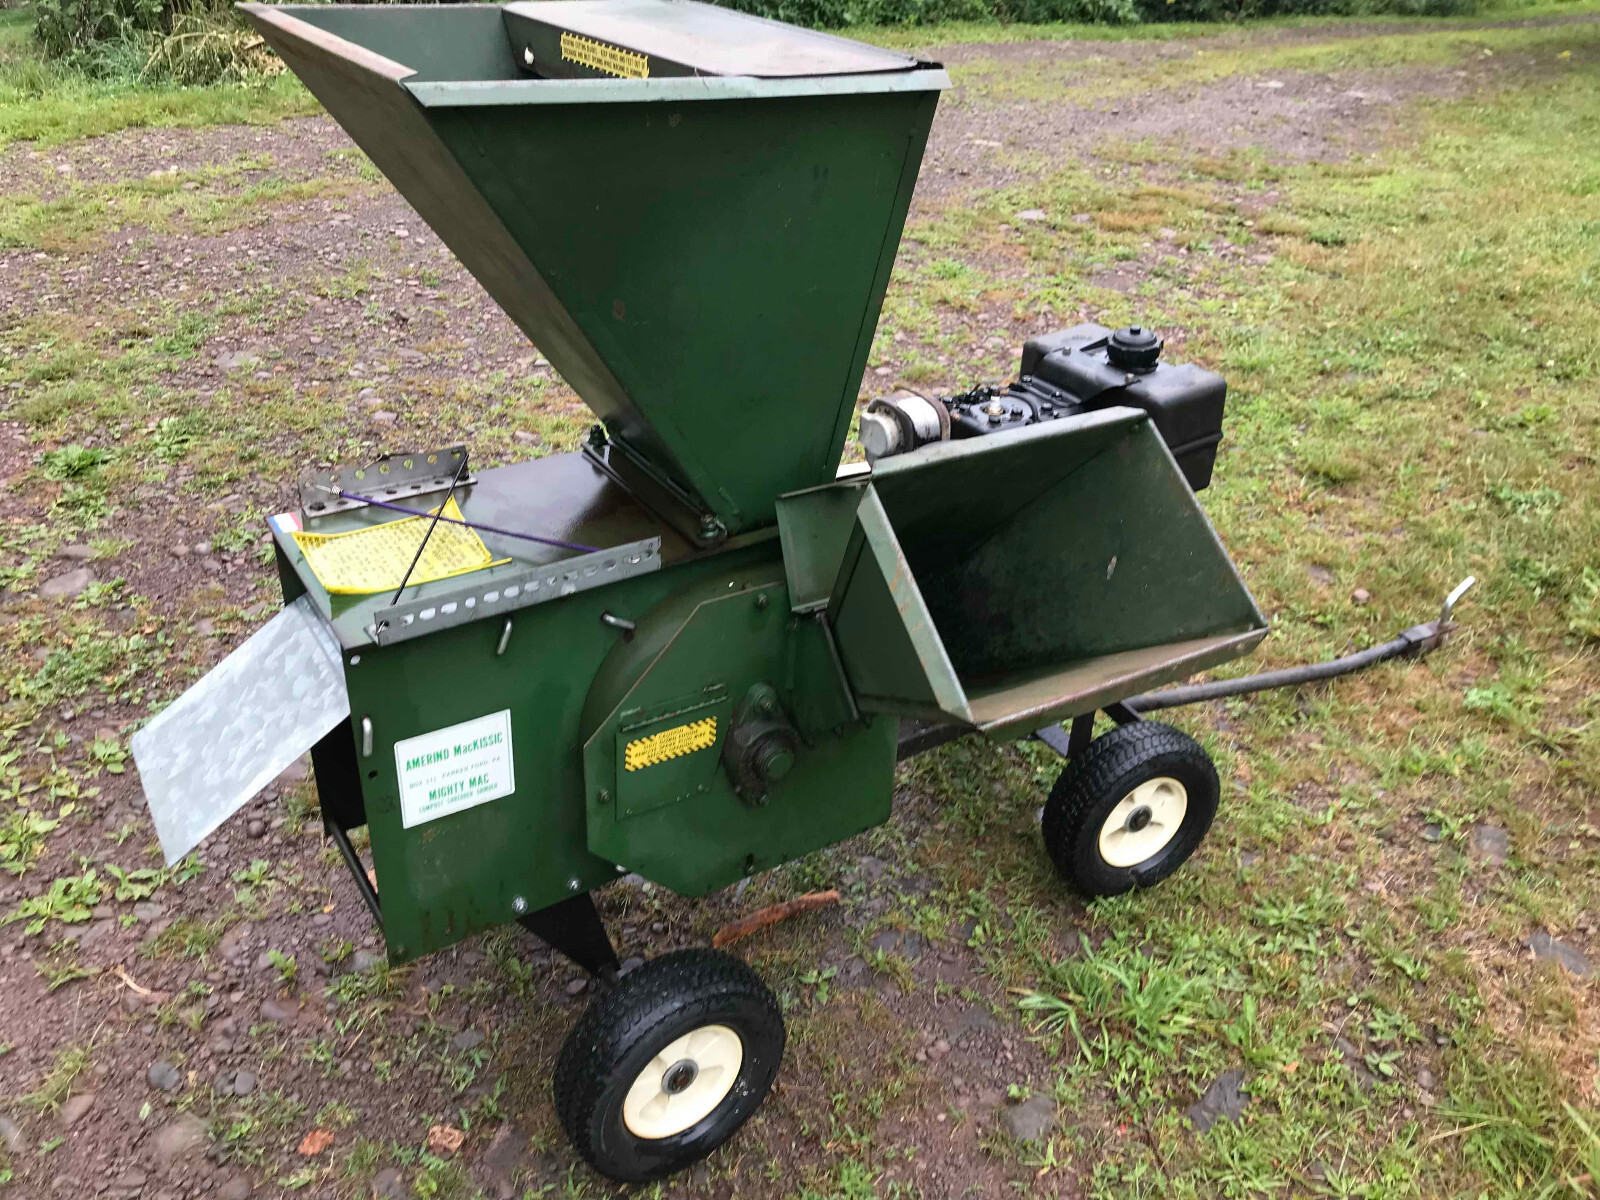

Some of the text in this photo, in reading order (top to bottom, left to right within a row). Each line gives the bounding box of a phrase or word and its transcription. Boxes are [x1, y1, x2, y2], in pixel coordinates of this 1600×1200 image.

[406, 732, 502, 772] AMERIND MacKISSIC
[429, 773, 489, 801] MIGHTY MAC
